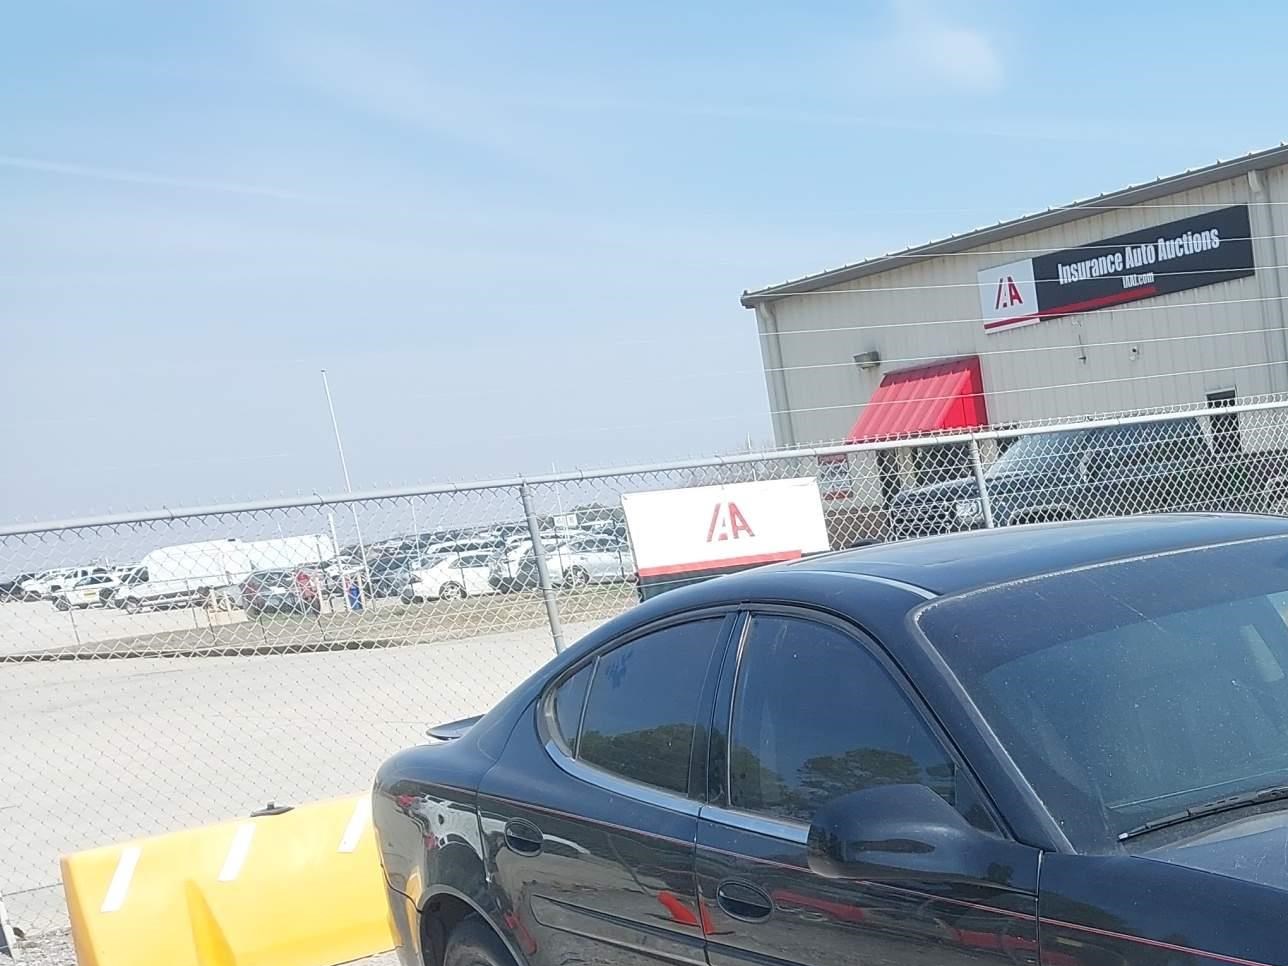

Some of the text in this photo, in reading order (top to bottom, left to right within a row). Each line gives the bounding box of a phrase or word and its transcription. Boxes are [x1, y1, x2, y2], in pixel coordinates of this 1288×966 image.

[1058, 229, 1220, 285] Insurance Auto Auctions
